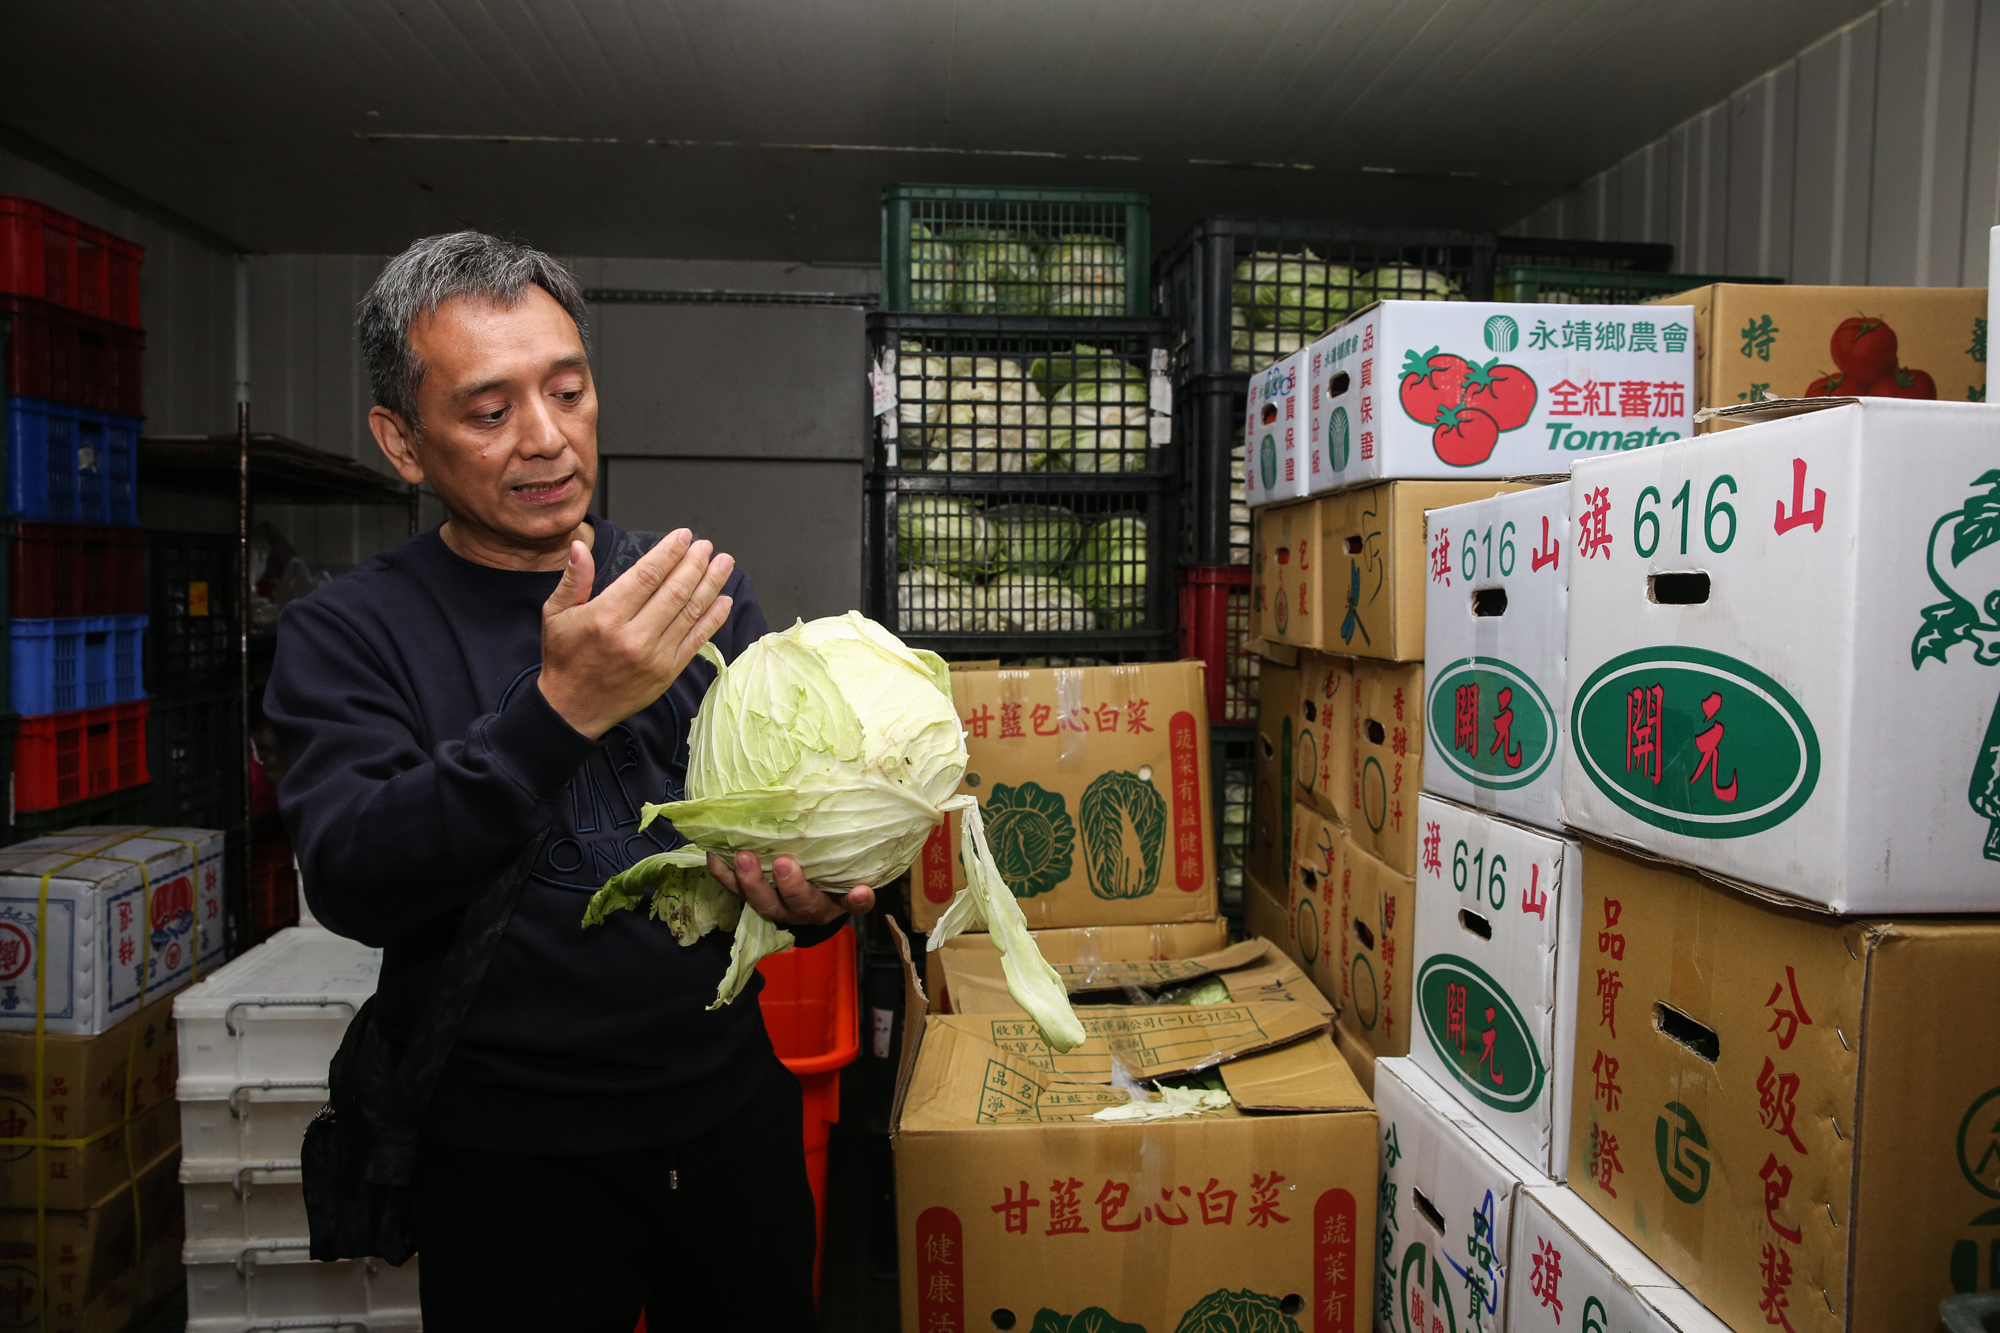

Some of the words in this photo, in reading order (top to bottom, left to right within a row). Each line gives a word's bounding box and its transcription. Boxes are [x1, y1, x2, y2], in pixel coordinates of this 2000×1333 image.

[1528, 319, 1689, 353] 永靖鄉農會
[1360, 324, 1374, 461] 品質保證
[1548, 379, 1685, 418] 全紅蕃茄
[1430, 527, 1452, 588] 旗
[1461, 520, 1516, 581] 616
[1531, 515, 1560, 573] 山
[1577, 486, 1614, 561] 旗
[1633, 474, 1738, 559] 616
[1773, 457, 1827, 536] 山
[965, 699, 1155, 740] 甘藍包心白菜
[1390, 687, 1408, 833] 香甜多汁
[1454, 683, 1522, 769] 開元
[1626, 684, 1739, 802] 開元
[1175, 727, 1200, 879] 蔬菜有益健康
[1423, 821, 1442, 880] 旗
[1452, 839, 1508, 911] 616
[1521, 863, 1548, 921] 山
[992, 1070, 1032, 1100] 品名
[1446, 982, 1504, 1086] 開元
[1591, 896, 1626, 1200] 品質保證
[1756, 965, 1813, 1333] 分級包裝
[991, 1171, 1291, 1237] 甘藍包心白菜
[1321, 1215, 1351, 1333] 蔬菜有
[1463, 1206, 1493, 1333] 品質
[1529, 1235, 1564, 1326] 旗
